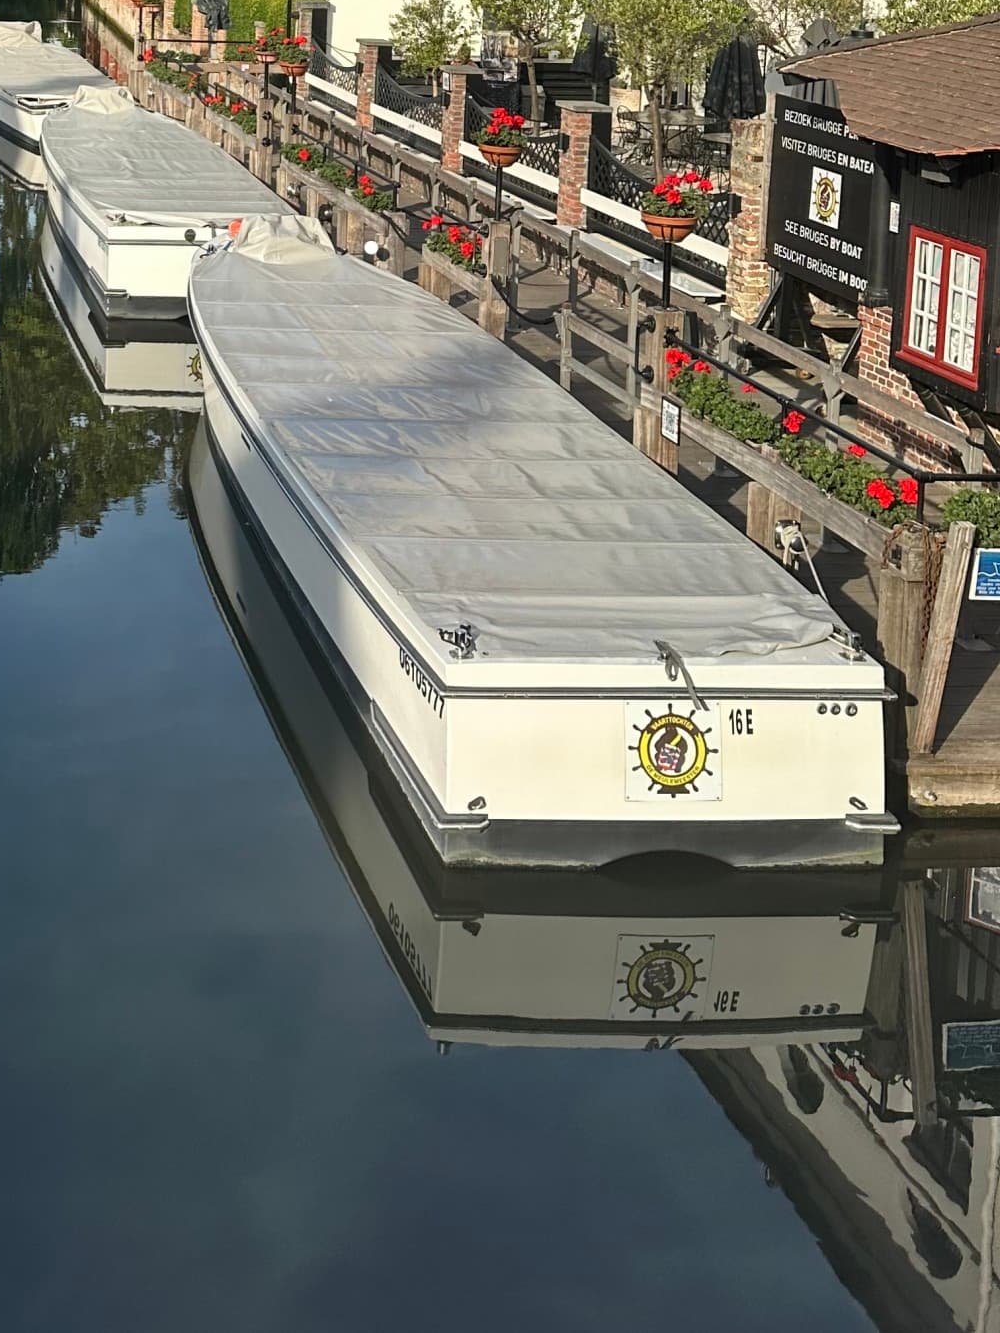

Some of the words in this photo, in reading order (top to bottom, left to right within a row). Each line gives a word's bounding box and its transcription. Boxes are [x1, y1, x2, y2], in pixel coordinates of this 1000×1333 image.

[784, 109, 812, 128] BEZOEK
[812, 117, 843, 137] BRUGGE
[781, 135, 807, 154] VISITEZ
[807, 143, 837, 164] BRUGES
[837, 152, 849, 167] EN
[849, 156, 875, 175] BATEA
[784, 219, 799, 236] SEE
[799, 225, 829, 247] BRUGES
[829, 237, 841, 252] BY
[841, 241, 863, 260] BOAT
[773, 242, 807, 267] BESUCHT
[806, 256, 838, 281] BRÜGGE
[838, 269, 849, 285] IM
[849, 273, 868, 292] BOO
[400, 647, 445, 720] 06105777
[728, 708, 743, 736] 16
[745, 708, 754, 735] E
